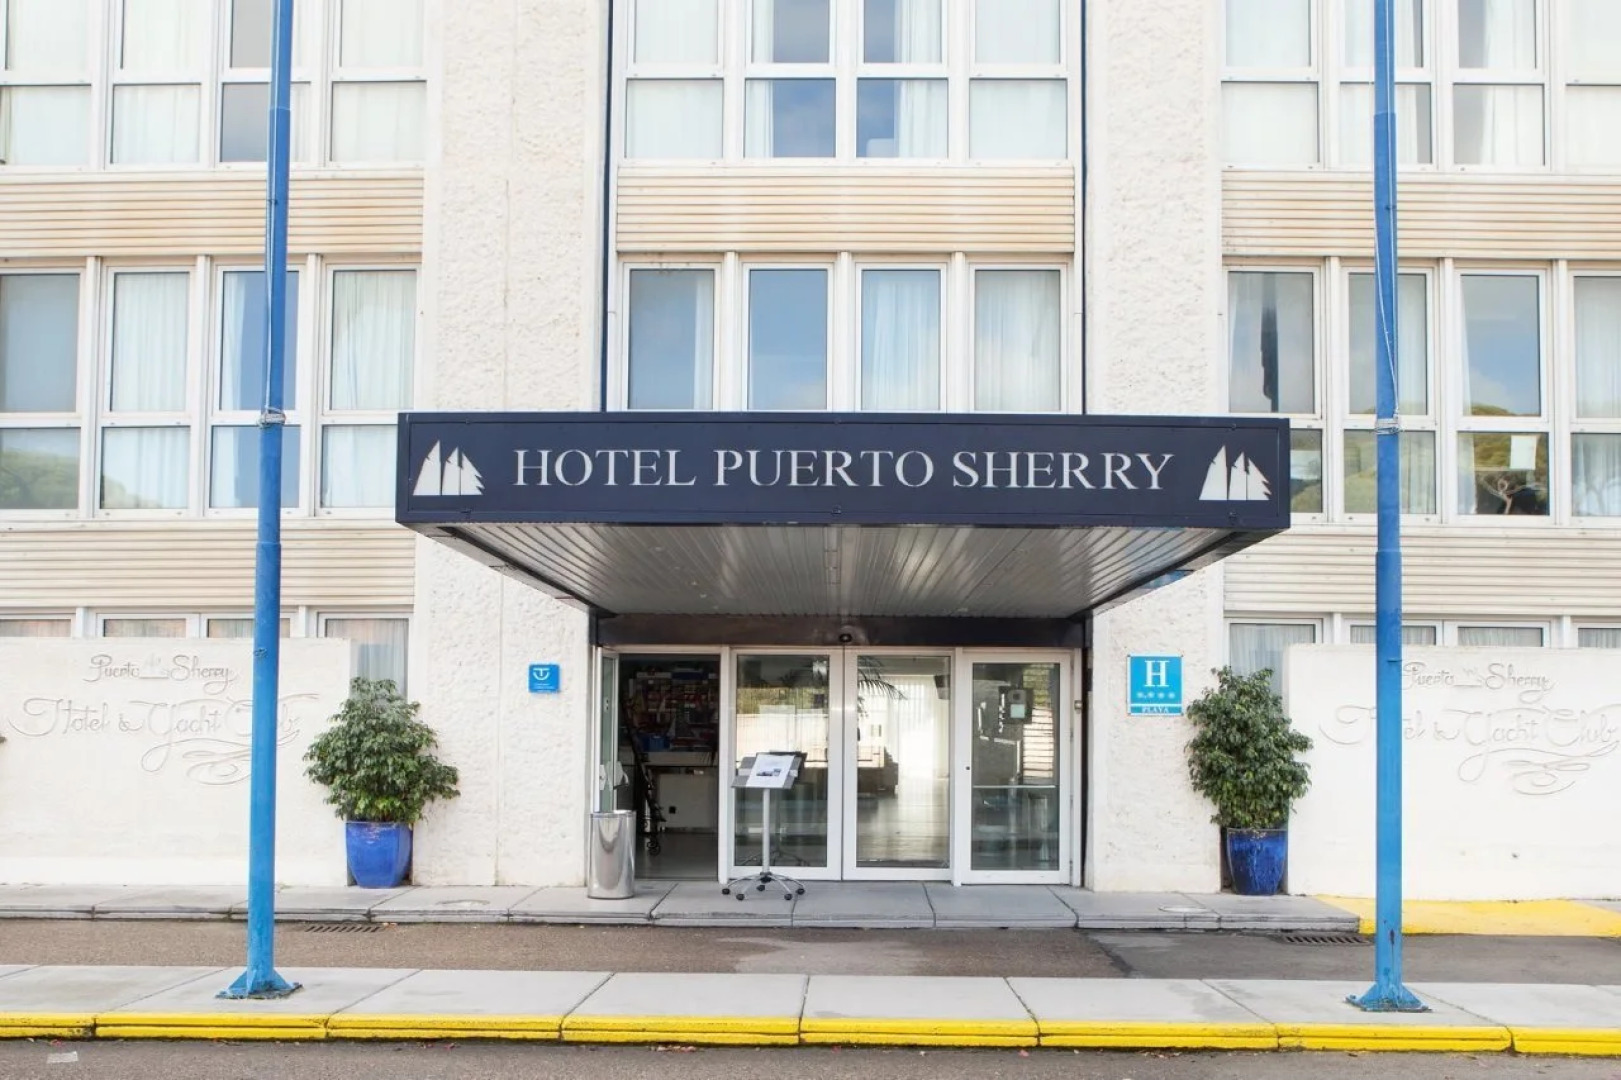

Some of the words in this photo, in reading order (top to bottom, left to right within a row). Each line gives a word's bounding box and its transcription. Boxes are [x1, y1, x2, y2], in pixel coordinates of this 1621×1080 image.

[513, 449, 696, 487] HOTEL
[714, 449, 936, 488] PUERTO
[952, 450, 1175, 490] SHERRY
[83, 653, 140, 683] Puerto
[170, 654, 239, 696] Sherry
[1144, 660, 1170, 687] H
[1485, 663, 1557, 705] Sherry
[8, 697, 108, 738] Hotel
